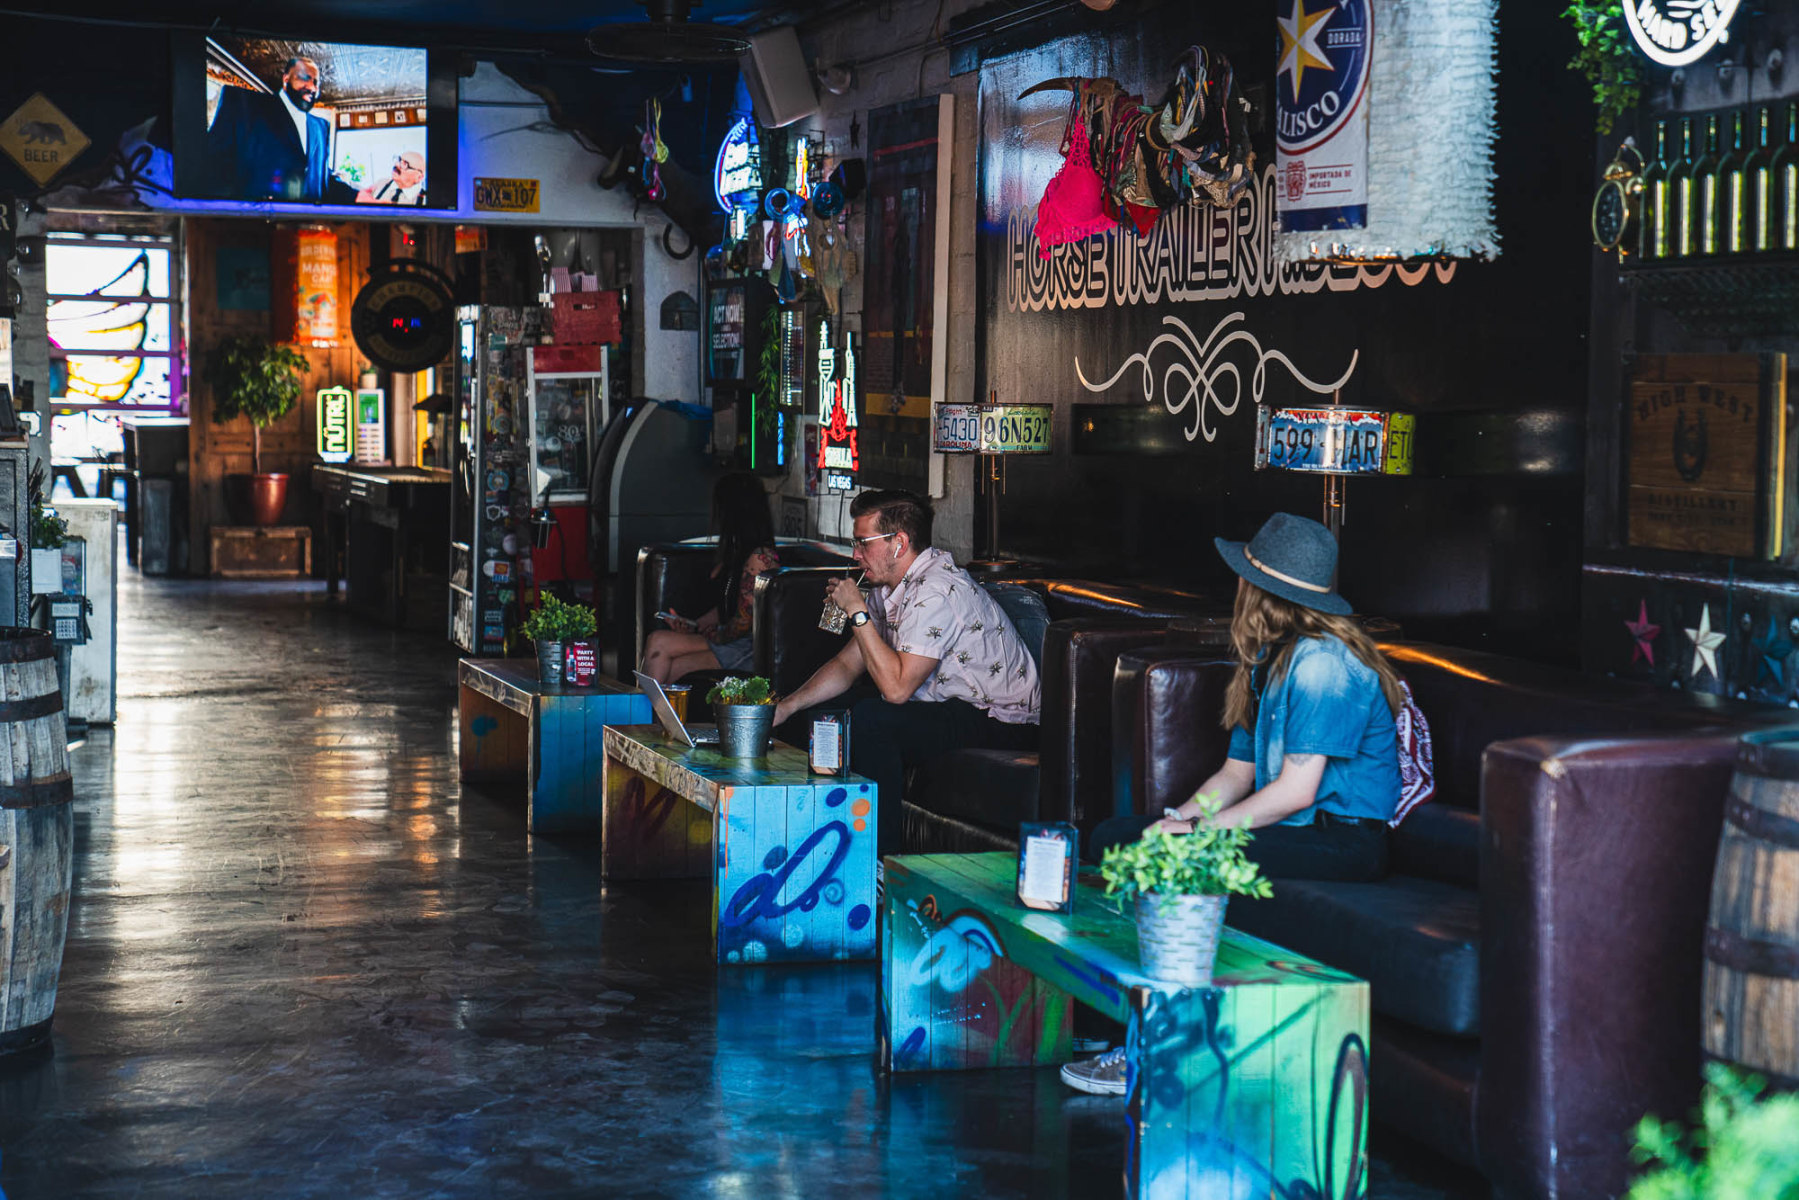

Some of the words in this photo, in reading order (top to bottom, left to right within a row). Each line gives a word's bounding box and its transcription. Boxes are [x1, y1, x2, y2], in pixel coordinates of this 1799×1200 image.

[1327, 32, 1361, 44] DORADA
[24, 148, 59, 163] BEER
[1308, 170, 1343, 180] IMPORTADA
[1344, 169, 1352, 178] DE
[514, 187, 536, 206] 107
[1007, 204, 1109, 313] HORSE
[1113, 188, 1262, 306] TRAILER
[713, 305, 725, 324] ACT
[725, 304, 740, 323] NOW
[1638, 385, 1687, 421] HIGH
[1698, 384, 1754, 423] WEST
[1274, 427, 1313, 460] 599
